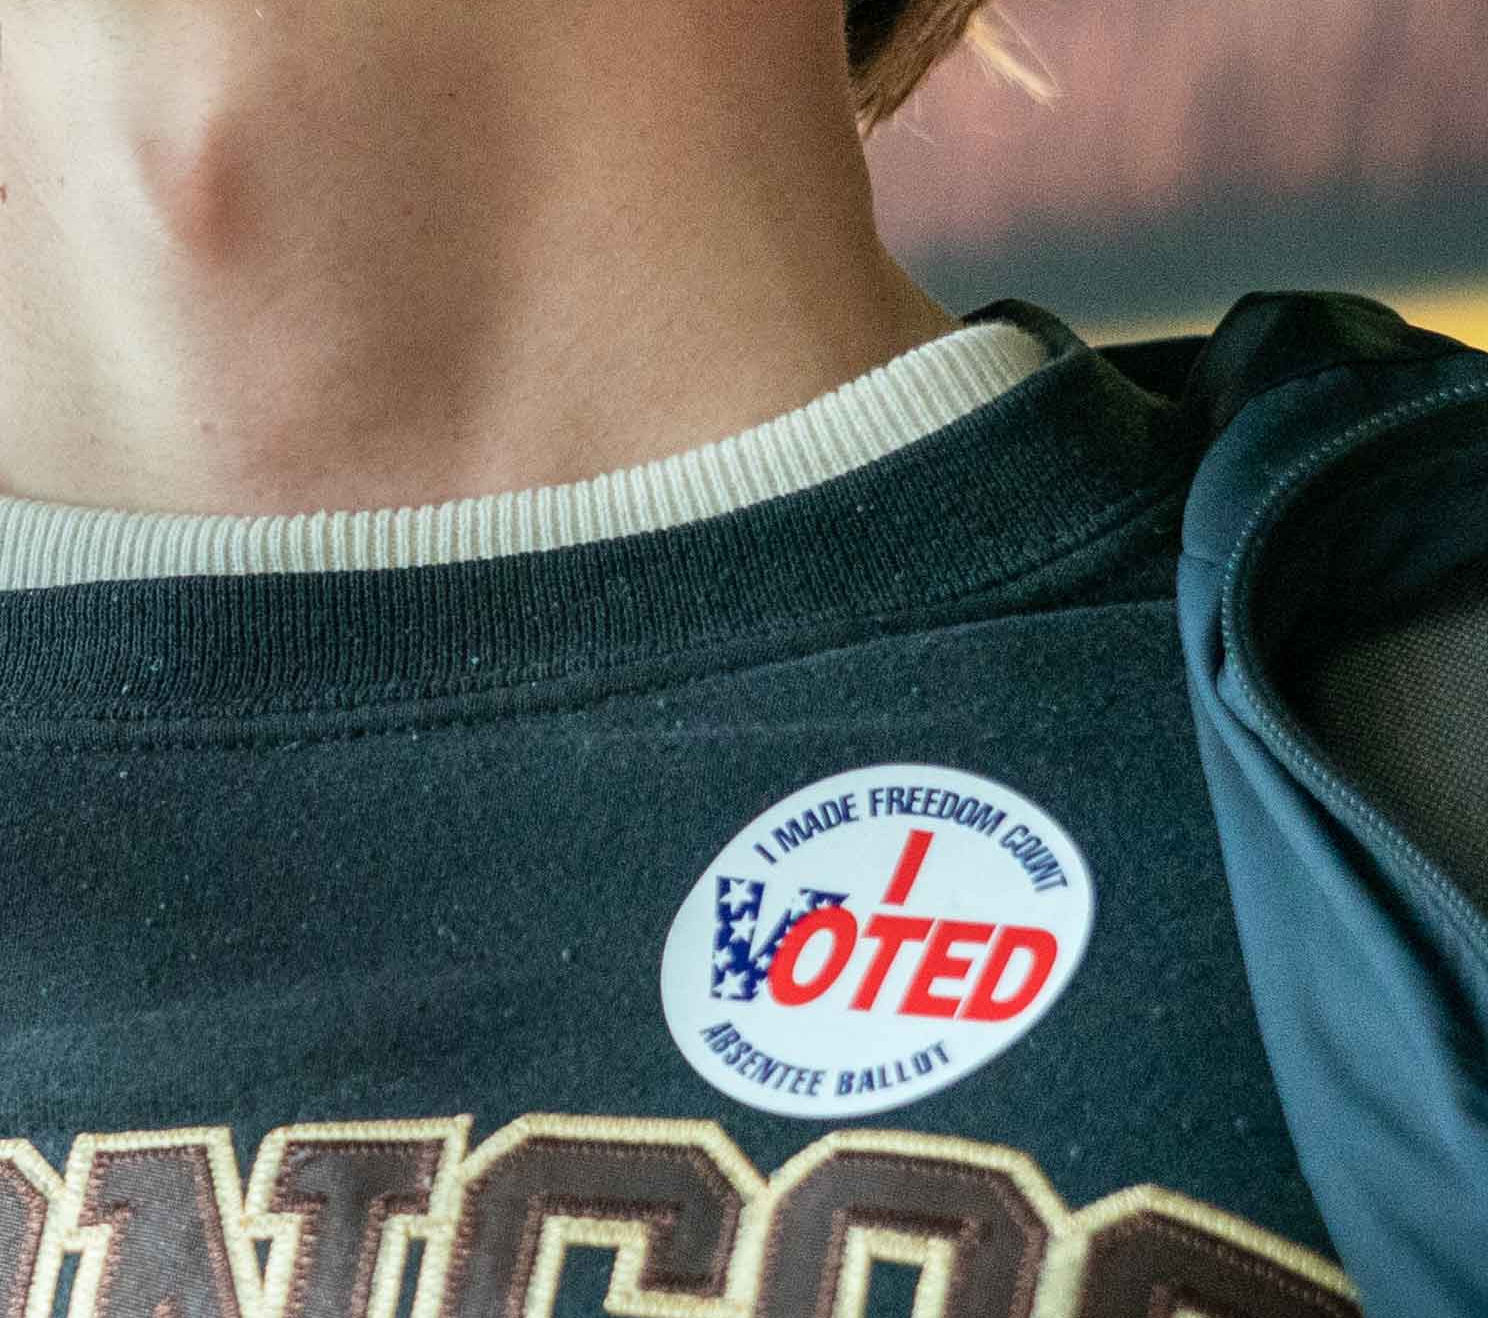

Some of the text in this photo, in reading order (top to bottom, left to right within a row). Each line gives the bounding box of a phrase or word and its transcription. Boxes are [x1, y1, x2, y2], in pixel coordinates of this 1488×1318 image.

[753, 786, 1069, 894] I MADE FREEDOM COUNT
[881, 828, 935, 906] I
[710, 875, 1059, 1024] VOTED
[700, 1019, 952, 1097] ABSENTEE BALLOT
